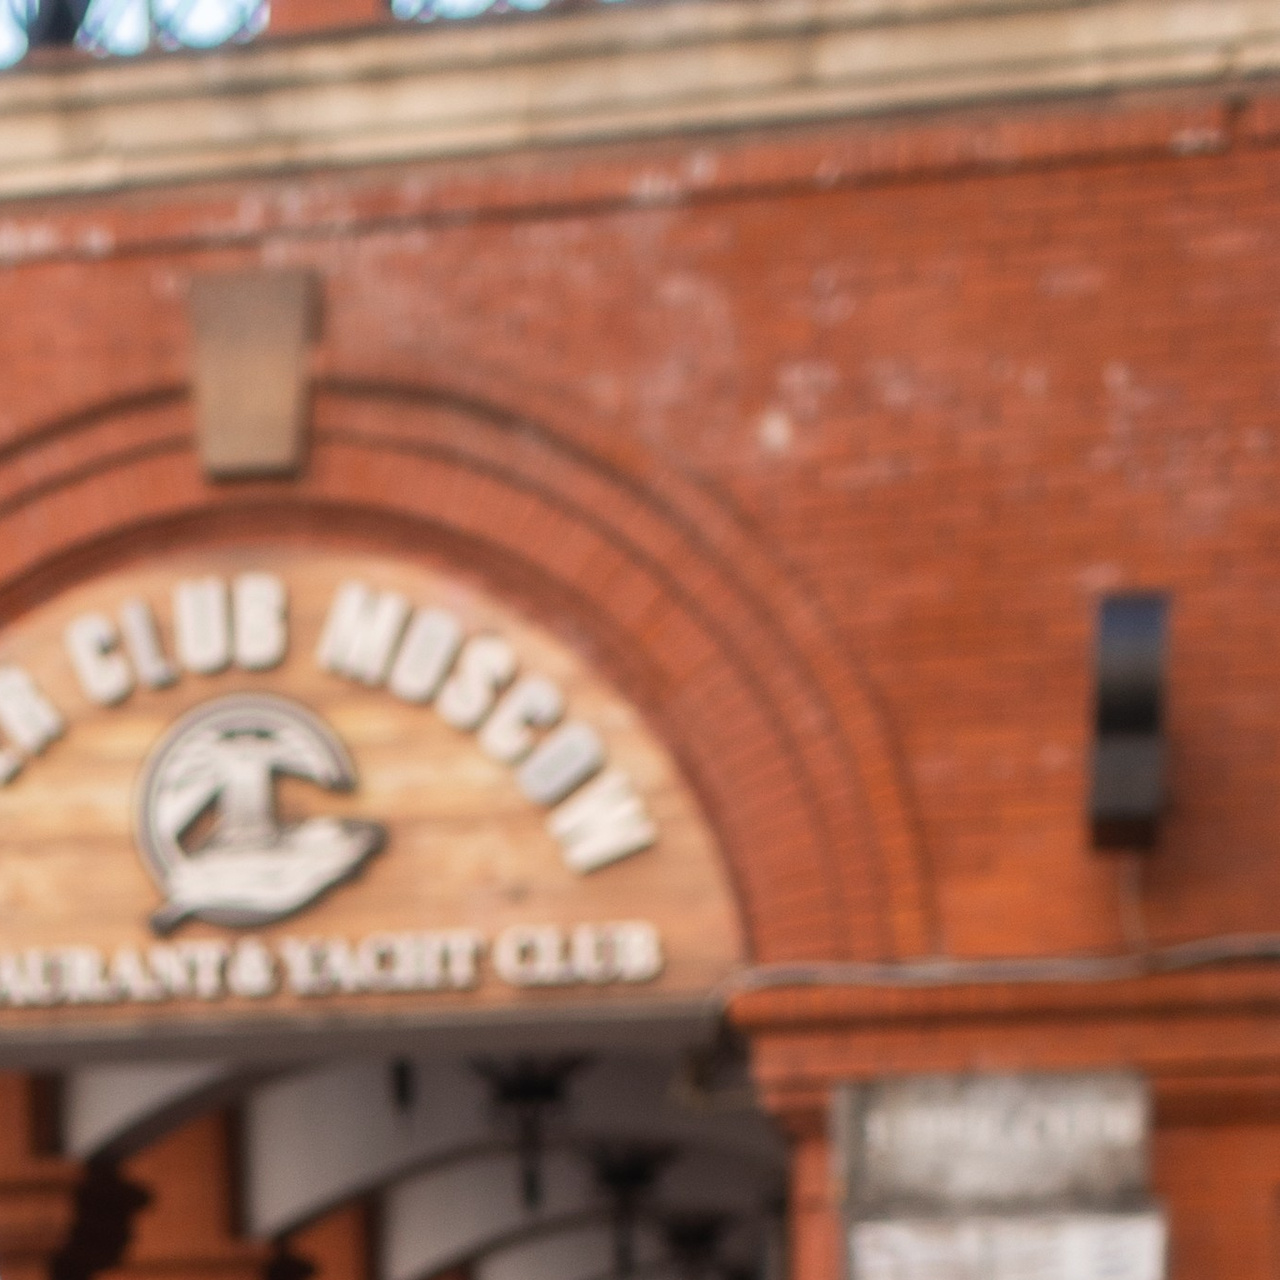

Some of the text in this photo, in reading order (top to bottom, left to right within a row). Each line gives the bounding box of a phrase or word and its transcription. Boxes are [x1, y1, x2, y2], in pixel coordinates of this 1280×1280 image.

[66, 571, 288, 706] CLUB
[317, 580, 658, 874] MOSCOW
[280, 928, 483, 996] YACHT
[494, 920, 665, 987] CLUB
